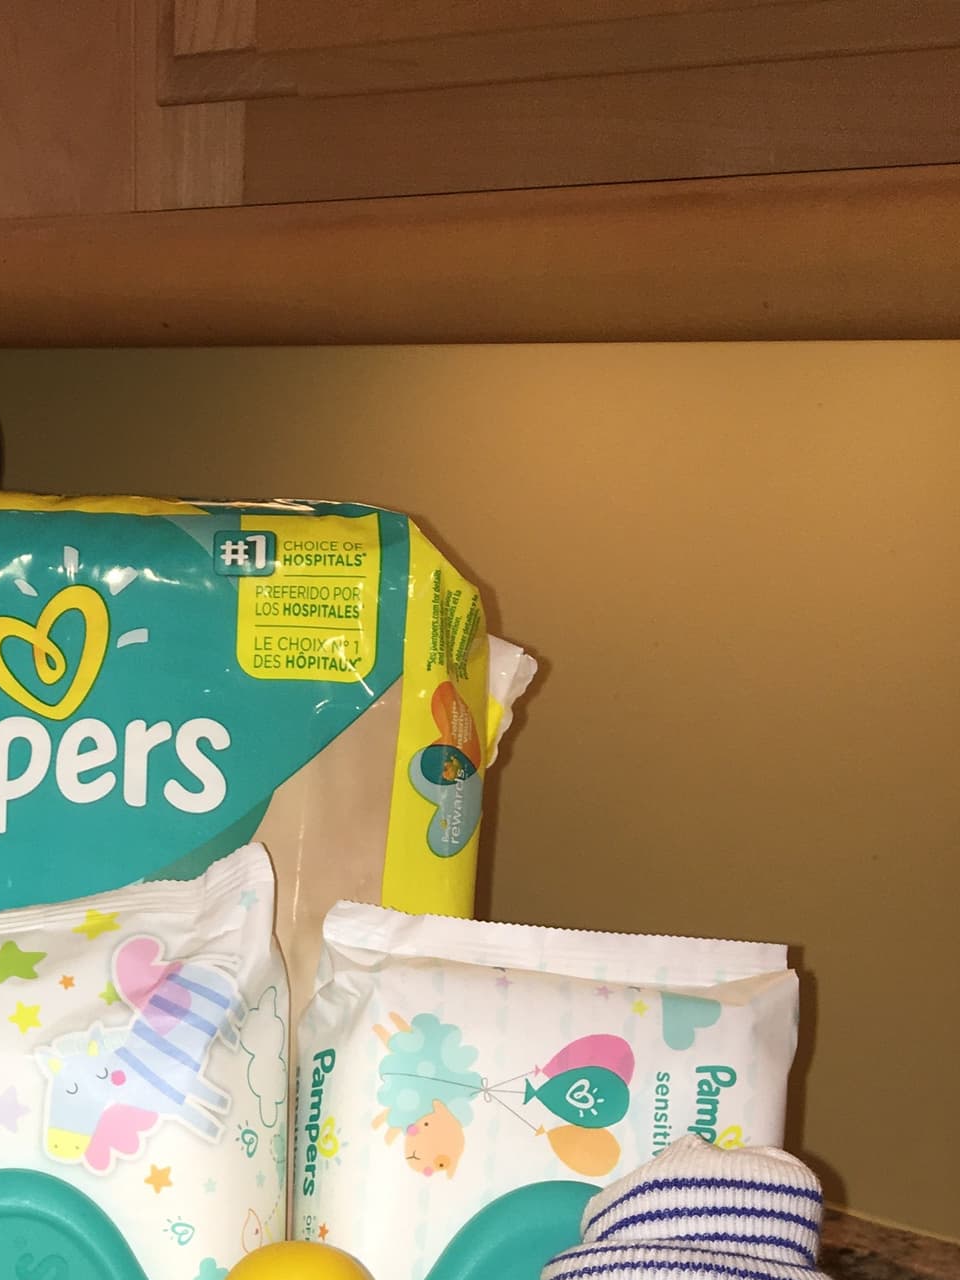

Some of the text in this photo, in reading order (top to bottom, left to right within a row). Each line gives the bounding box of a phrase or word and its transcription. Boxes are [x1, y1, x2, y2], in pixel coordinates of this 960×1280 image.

[220, 535, 266, 569] #1
[283, 541, 363, 551] CHOICE OF
[255, 585, 361, 601] PREFERIDO POR
[255, 602, 279, 616] LOS
[254, 636, 272, 650] LE
[277, 637, 327, 651] CHOIX
[253, 654, 281, 669] DES
[450, 768, 465, 844] rewards
[303, 1048, 336, 1196] Pampers
